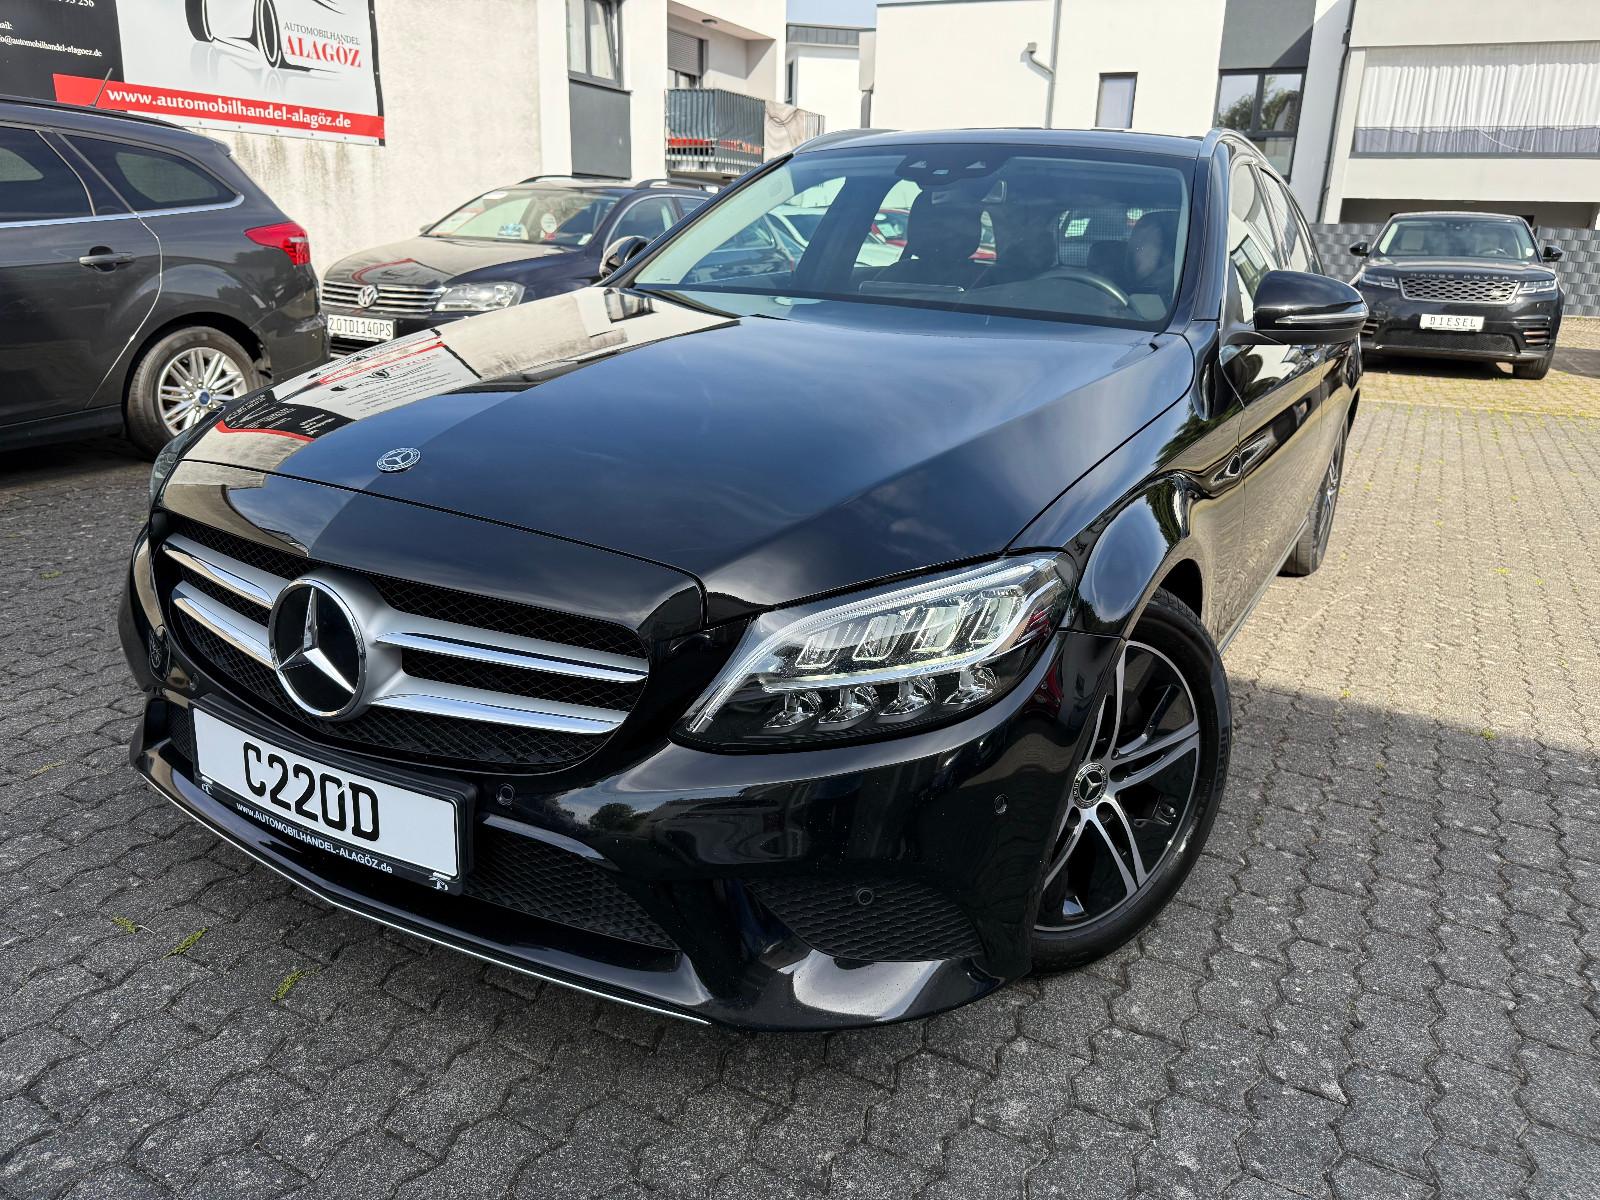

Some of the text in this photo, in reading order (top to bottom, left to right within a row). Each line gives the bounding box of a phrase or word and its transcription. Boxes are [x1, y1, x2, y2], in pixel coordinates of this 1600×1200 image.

[0, 35, 103, 57] o@automobilhandel-alagoez.de
[284, 21, 361, 46] AUTOMOBILHANDEL
[285, 34, 362, 68] ALAGÖZ
[106, 88, 352, 129] www.automobilhandel-alagöz.de
[1429, 316, 1477, 328] DIESEL
[243, 741, 380, 842] C220D
[236, 802, 393, 874] www.AUTOMOBILHANDEL-ALAGÖZ.de
